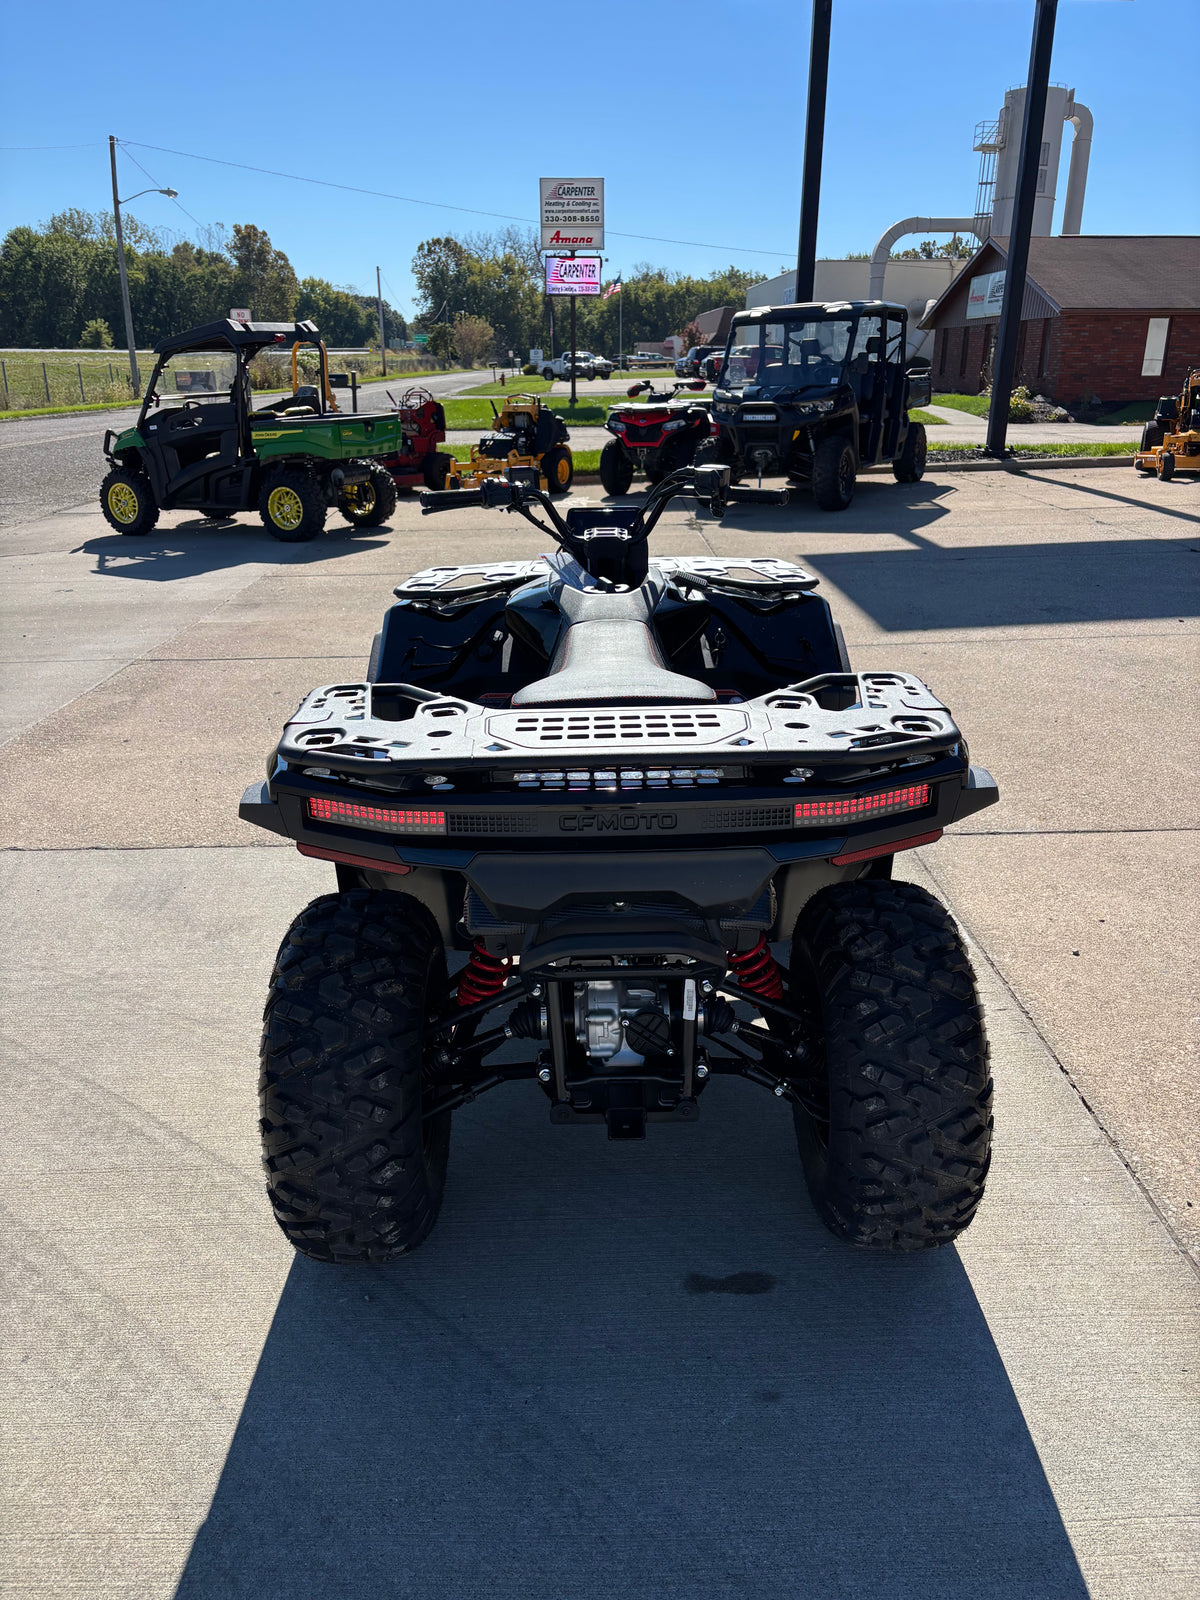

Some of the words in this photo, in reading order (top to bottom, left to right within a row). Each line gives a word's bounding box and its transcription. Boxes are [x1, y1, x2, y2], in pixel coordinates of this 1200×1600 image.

[557, 186, 596, 196] CARPENTER
[549, 230, 593, 244] Amana
[559, 264, 596, 278] CARPENTER
[559, 812, 678, 832] CFMOTO
